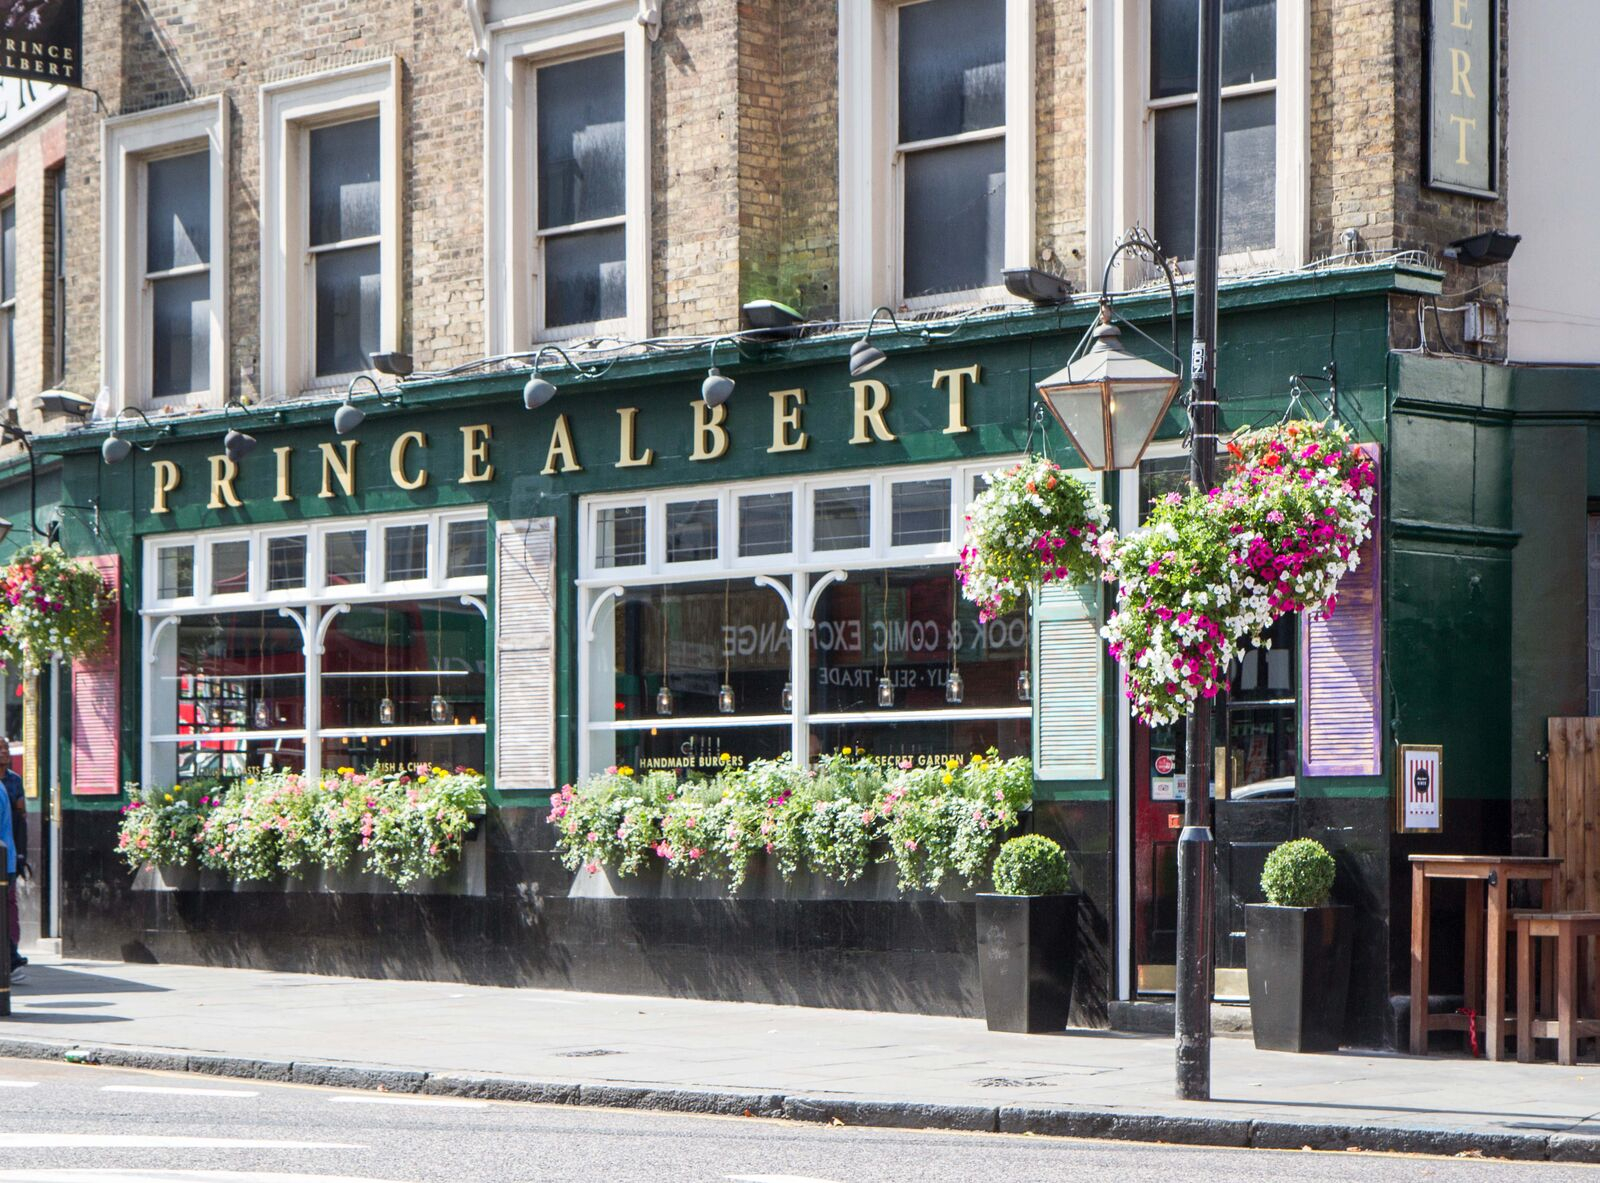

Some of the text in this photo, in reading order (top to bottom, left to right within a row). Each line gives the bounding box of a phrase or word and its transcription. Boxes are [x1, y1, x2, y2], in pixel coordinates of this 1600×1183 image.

[0, 38, 73, 60] RINCE
[0, 56, 73, 77] LBERT
[150, 363, 981, 514] PRINCE ALBERT
[379, 762, 396, 773] ISH
[640, 757, 695, 768] HANDMADE
